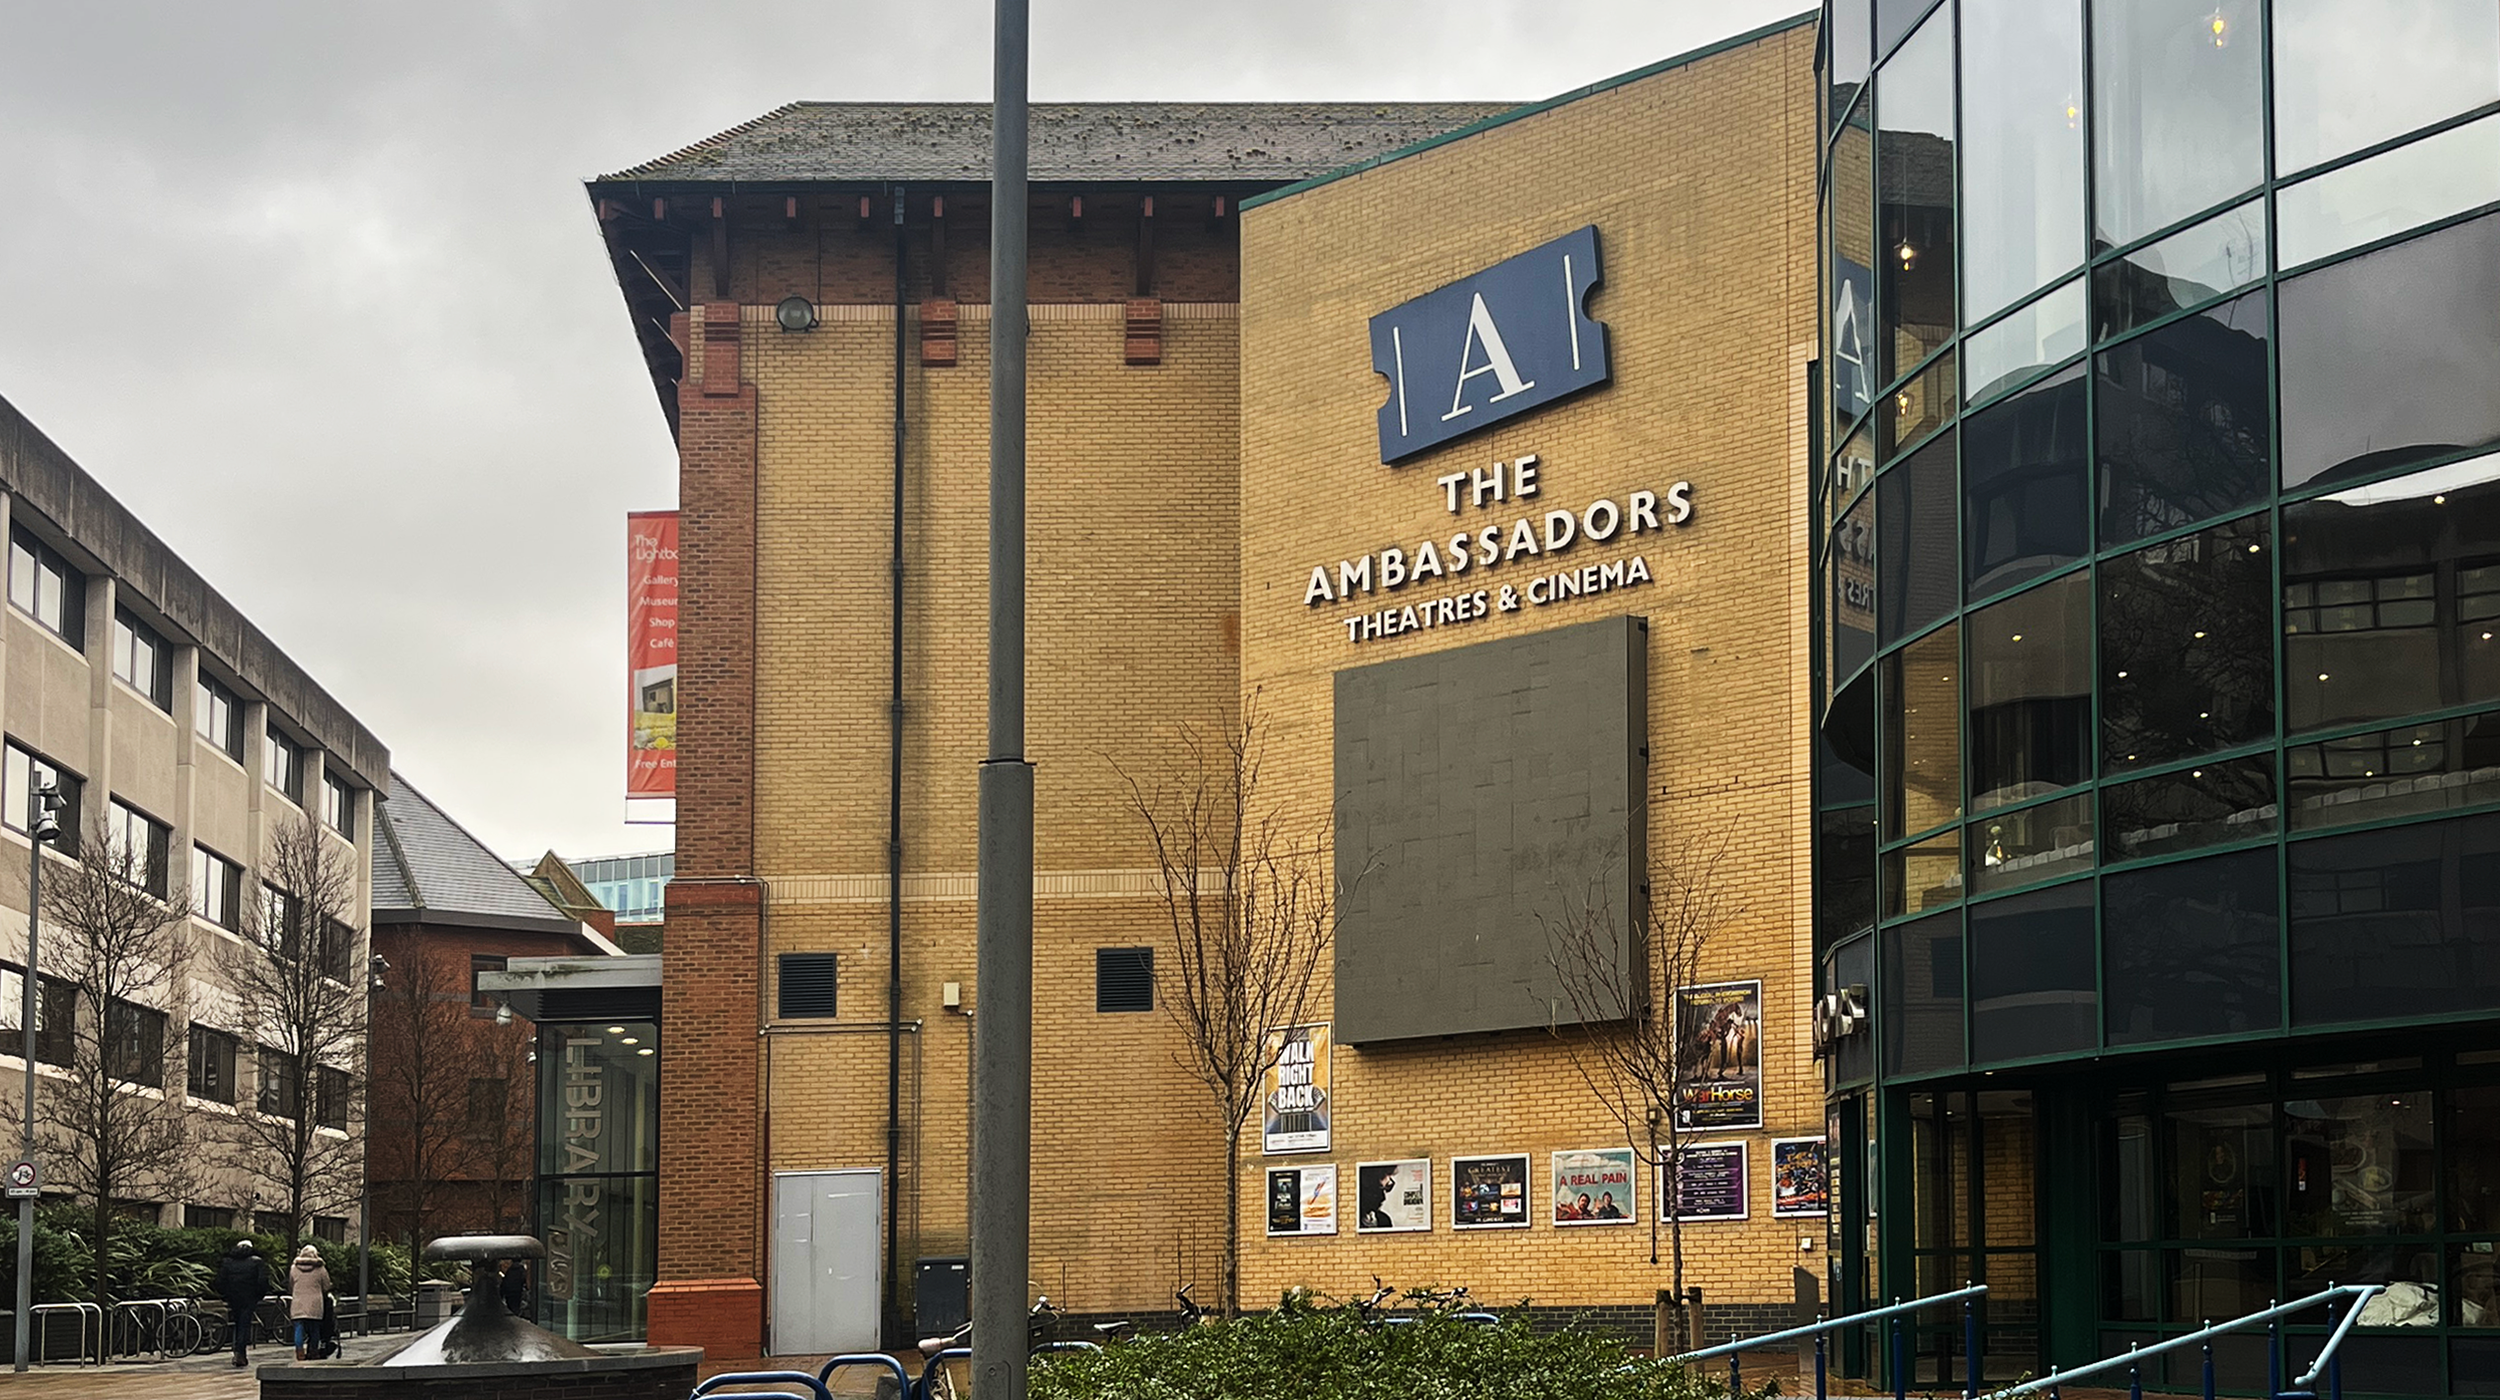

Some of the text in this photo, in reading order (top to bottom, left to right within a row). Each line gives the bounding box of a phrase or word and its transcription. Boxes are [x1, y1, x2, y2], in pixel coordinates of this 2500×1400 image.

[1440, 291, 1536, 422] A
[1438, 454, 1539, 513] THE
[634, 533, 658, 547] The
[1303, 481, 1693, 606] AMBASSADORS
[643, 574, 678, 588] Gallery
[1344, 556, 1651, 643] THEATRES & CINEMA
[648, 617, 675, 629] Shop
[649, 637, 675, 649] Café
[634, 757, 677, 769] Free Ent
[1278, 1040, 1315, 1065] WALK
[1278, 1063, 1315, 1086] RIGHT
[1277, 1085, 1314, 1110] BACK
[563, 1037, 602, 1238] LIBRARY
[1559, 1171, 1628, 1186] A REAL PAIN
